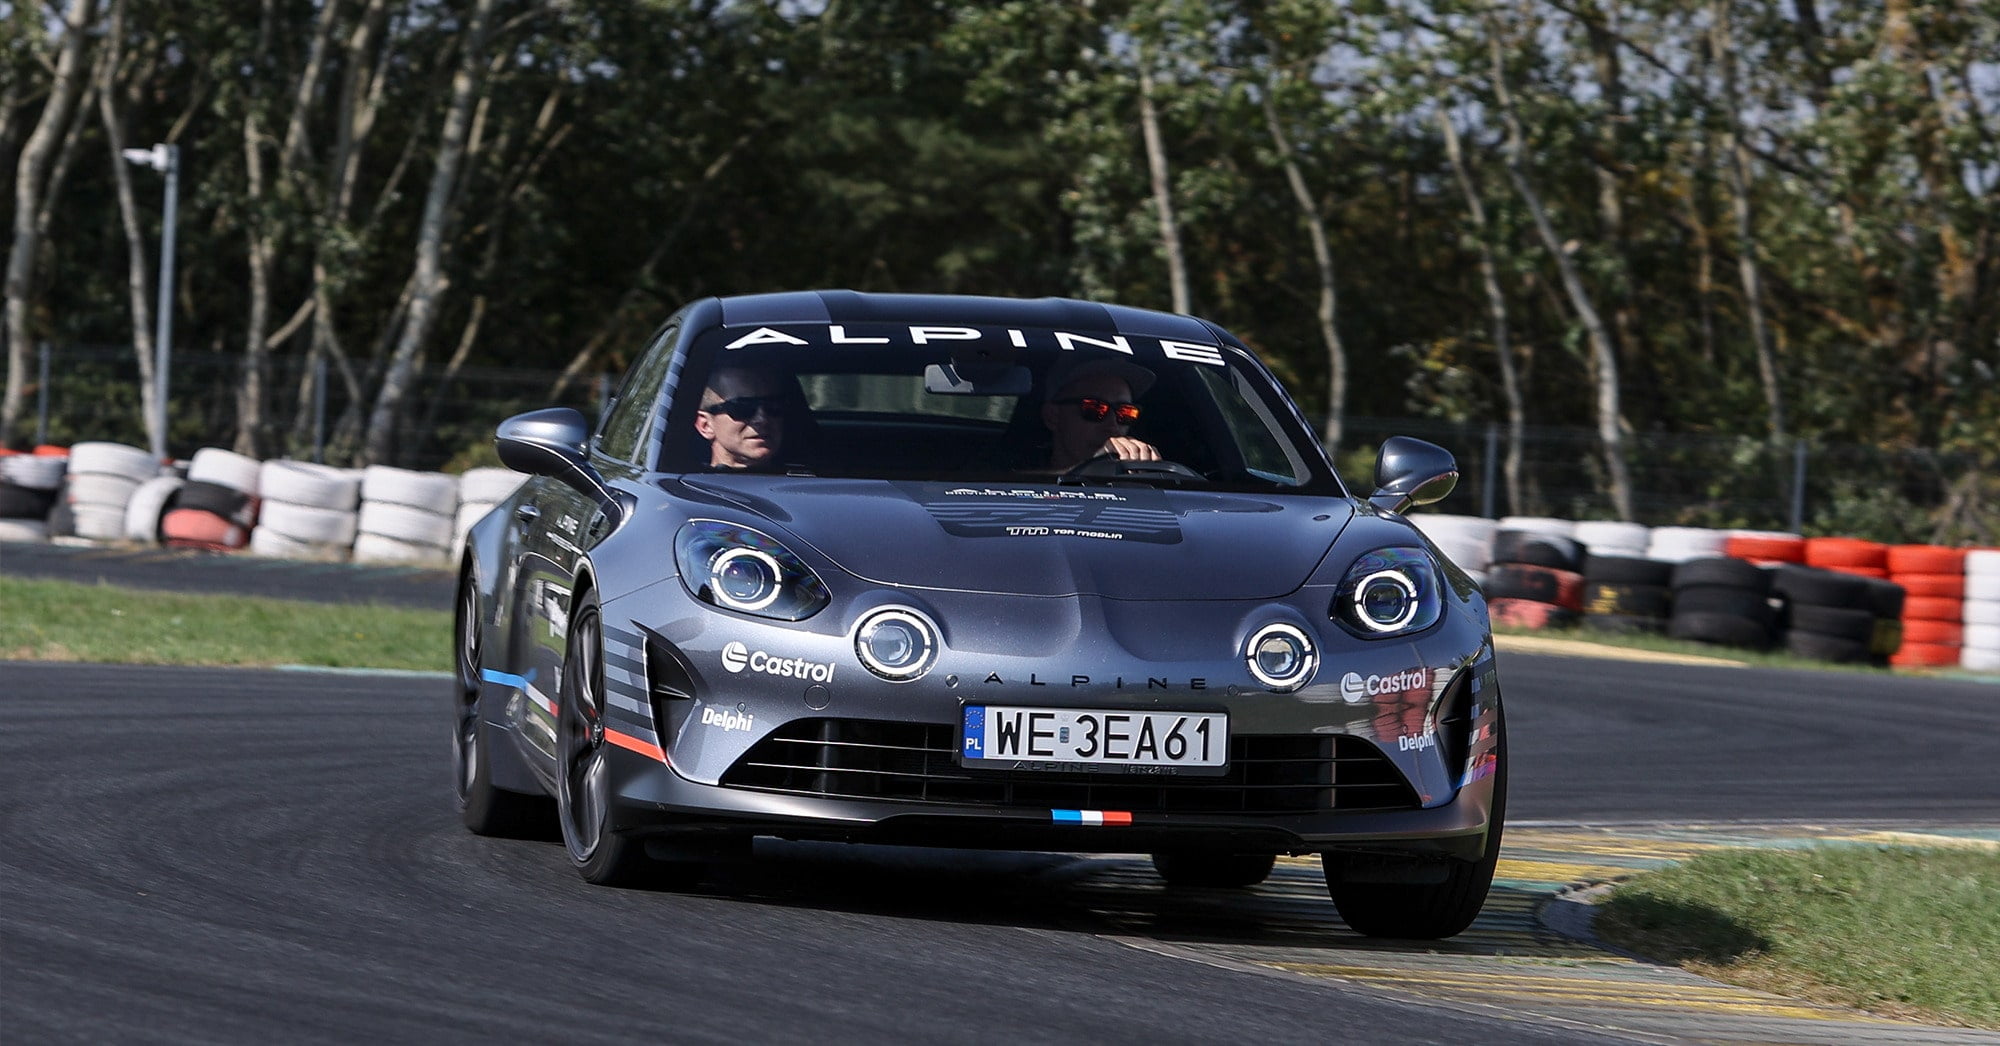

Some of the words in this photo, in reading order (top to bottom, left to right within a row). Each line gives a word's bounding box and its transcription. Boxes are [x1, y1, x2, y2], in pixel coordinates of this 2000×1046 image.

[724, 325, 1225, 367] ALPINE
[749, 650, 836, 683] Castrol
[984, 671, 1207, 690] ALPINE
[1367, 667, 1426, 695] Castrol
[701, 707, 754, 732] Delphi
[965, 737, 981, 750] PL
[996, 711, 1055, 757] WE
[1074, 714, 1210, 762] 3EA61
[1398, 730, 1435, 752] Delphi
[1013, 760, 1099, 773] ALPINE
